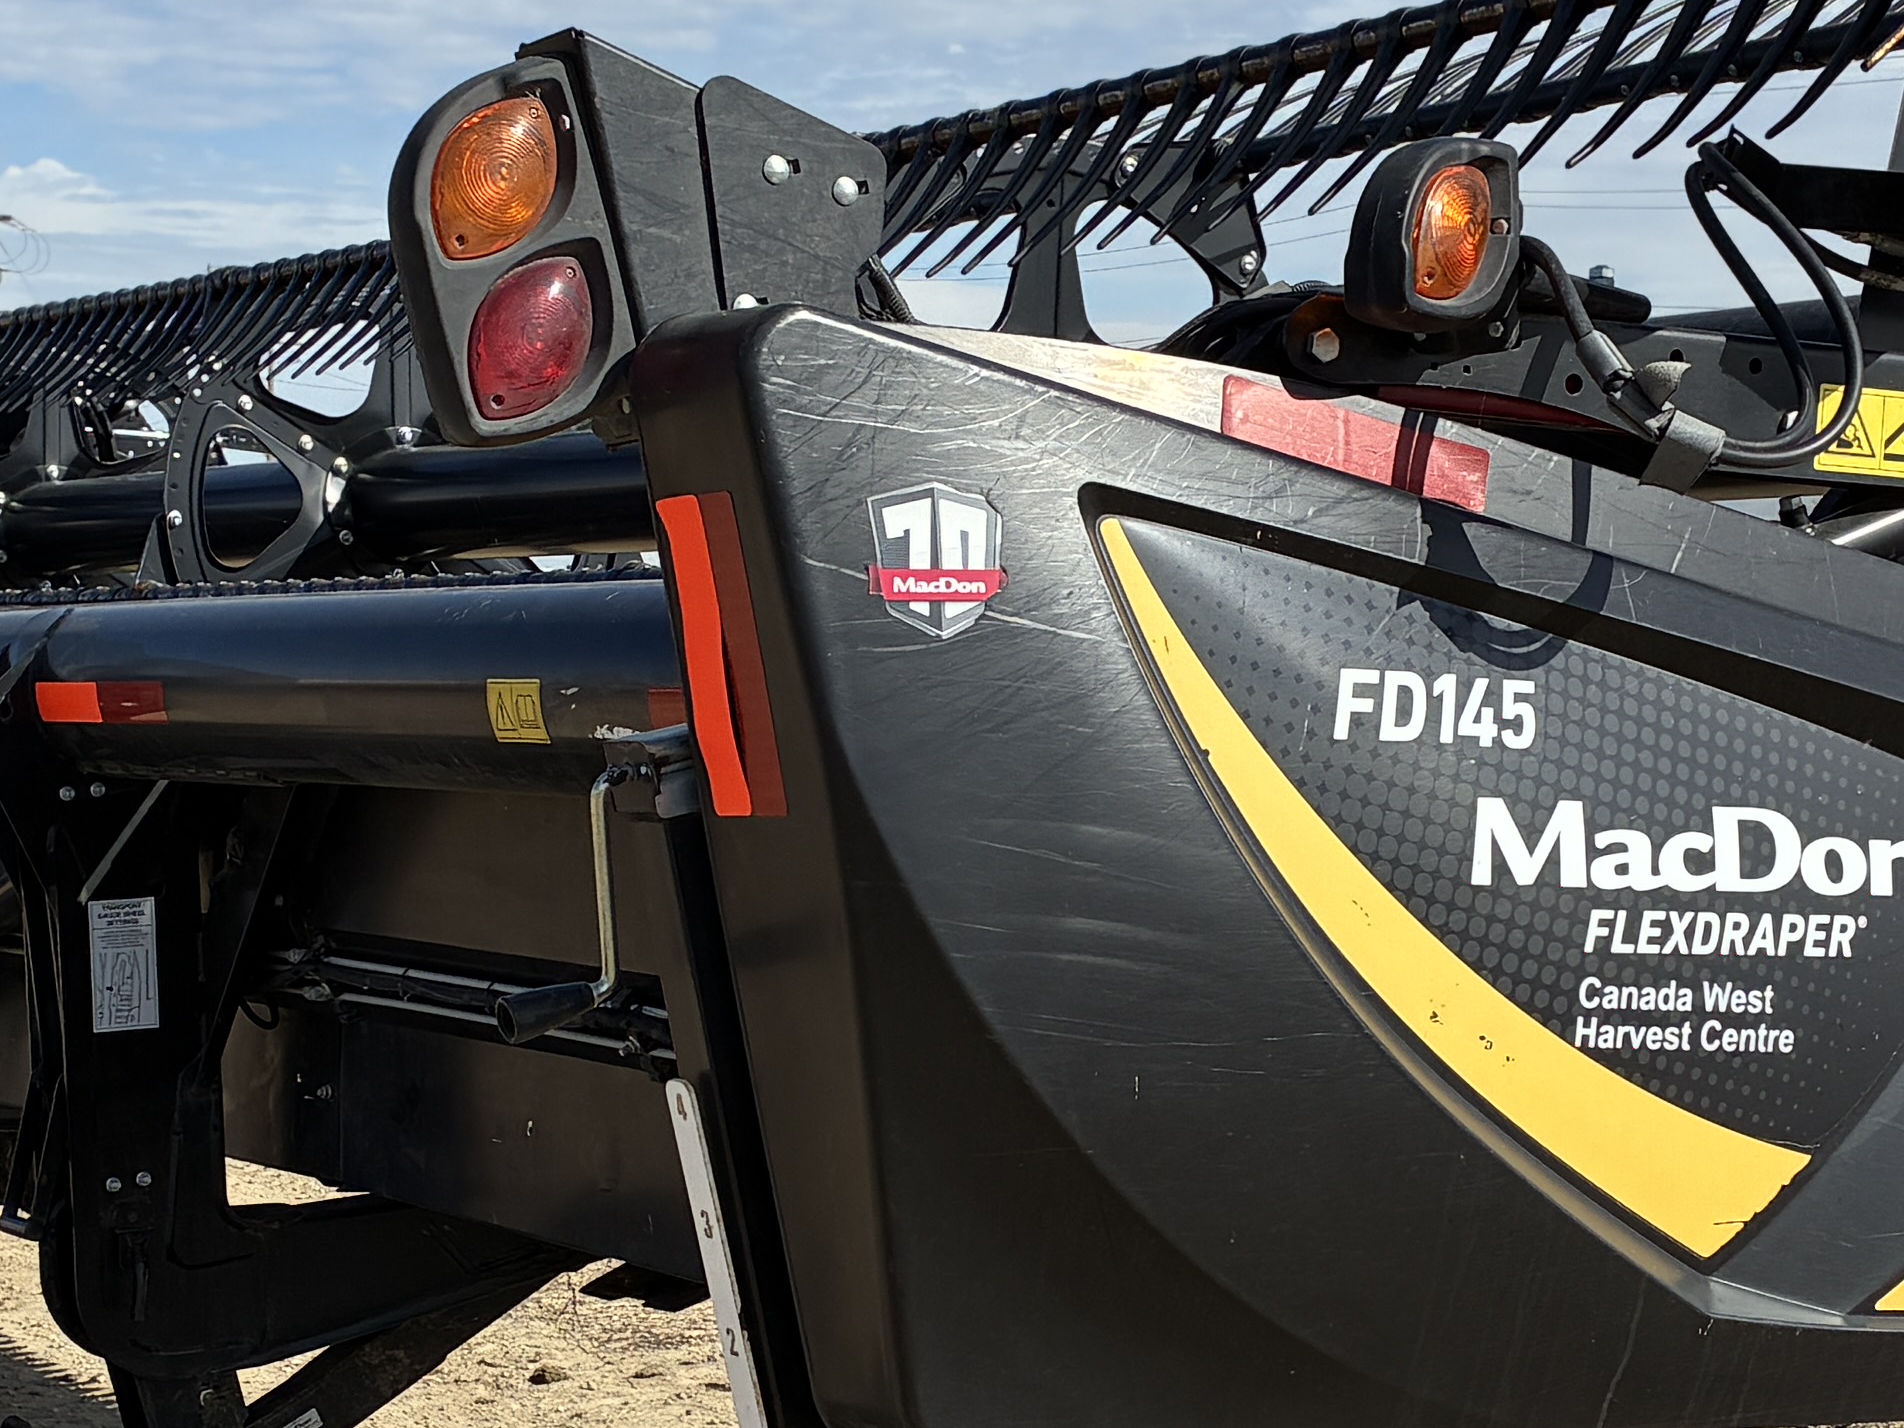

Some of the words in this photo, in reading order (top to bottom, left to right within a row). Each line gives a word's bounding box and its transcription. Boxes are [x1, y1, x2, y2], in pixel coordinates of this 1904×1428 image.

[893, 576, 987, 594] MacDon
[1333, 668, 1536, 749] FD145
[1583, 909, 1856, 958] FLEXDRAPER
[1579, 977, 1693, 1012] Canada
[1703, 981, 1775, 1014] West
[1574, 1016, 1693, 1052] Harvest
[1700, 1020, 1795, 1054] Centre
[676, 1093, 687, 1121] 4
[700, 1209, 713, 1239] 3
[726, 1328, 739, 1357] 2
